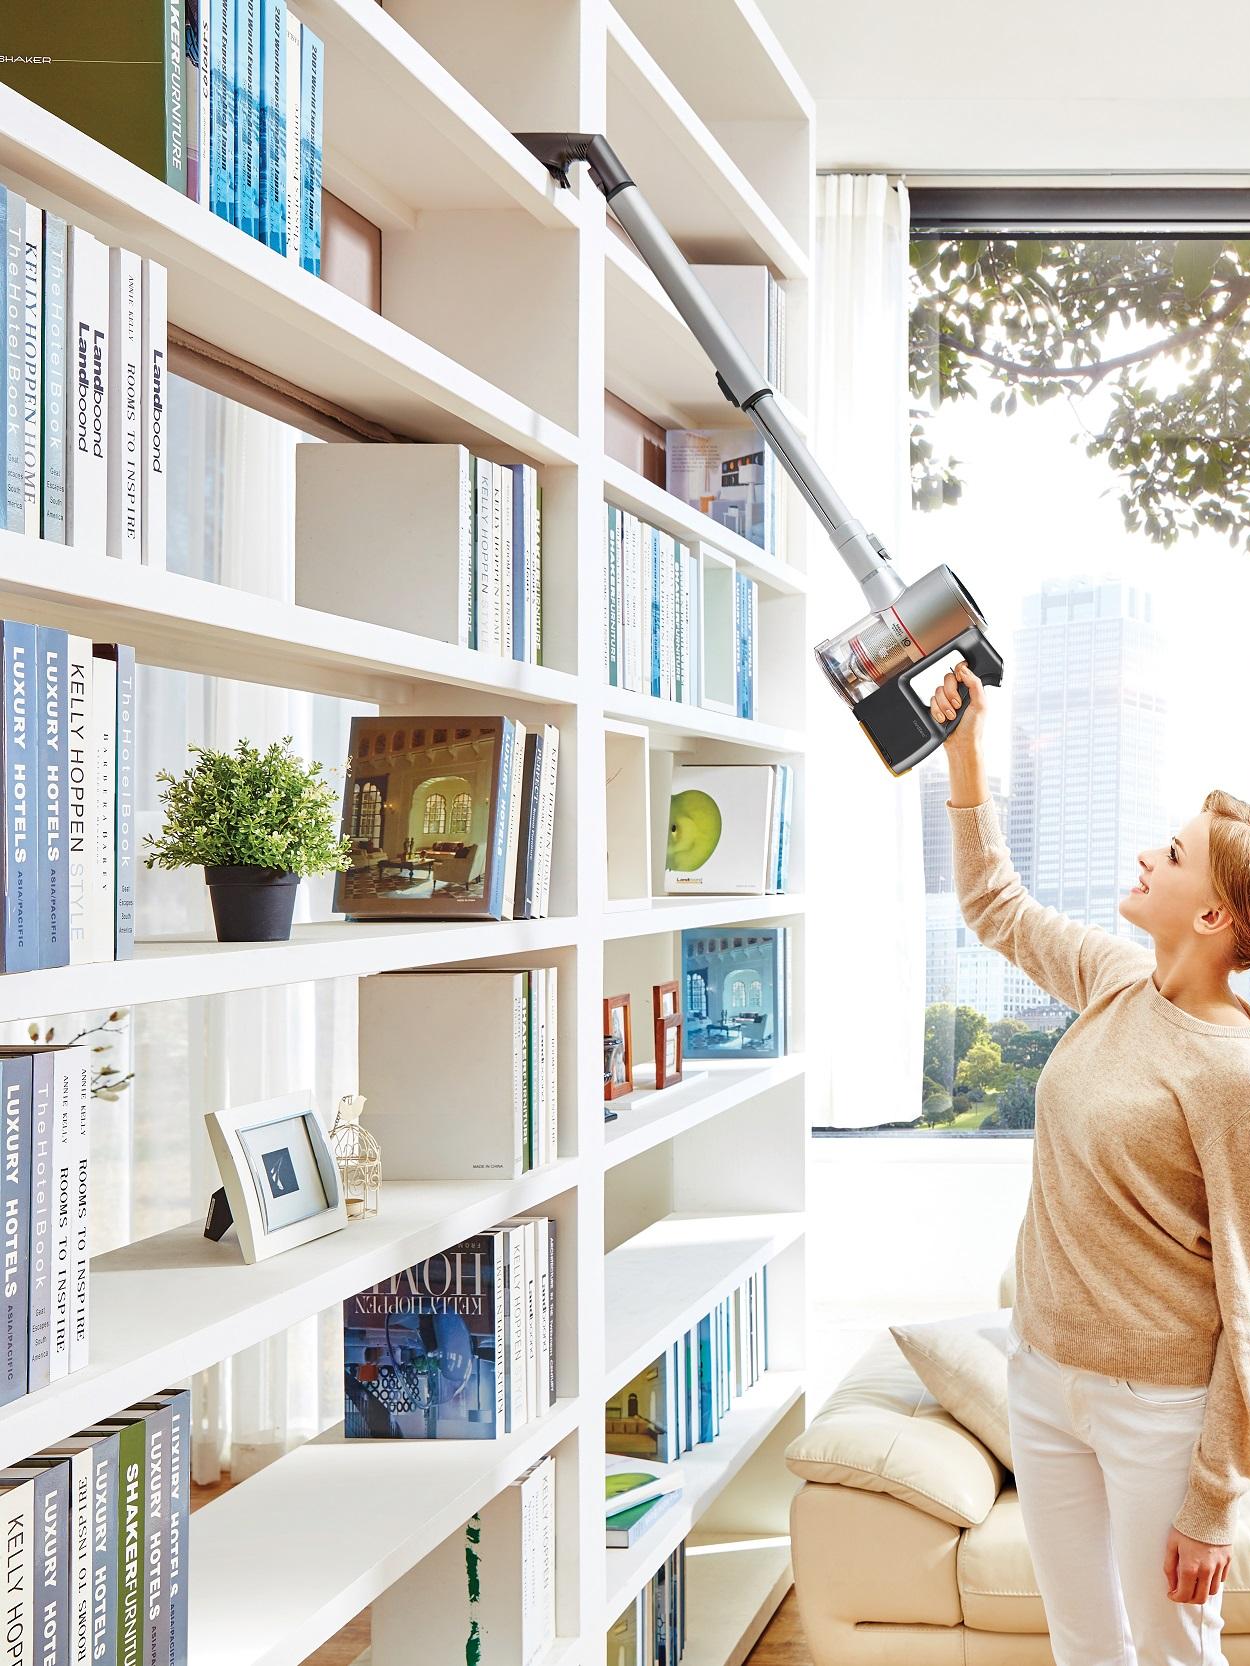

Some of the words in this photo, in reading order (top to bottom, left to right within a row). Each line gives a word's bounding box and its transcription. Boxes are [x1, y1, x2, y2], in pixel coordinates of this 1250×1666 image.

[25, 323, 37, 426] HOPPEN
[78, 321, 90, 453] Landboond
[93, 329, 105, 458] Landboond
[127, 363, 136, 421] ROOMS
[152, 349, 164, 474] Landboond
[24, 432, 36, 504] HOME
[127, 434, 135, 452] TO
[126, 460, 136, 540] INSPIRE
[481, 475, 489, 525] KELLY
[481, 528, 489, 594] HOPPEN
[13, 647, 26, 750] LUXURY
[46, 651, 59, 752] LUXURY
[70, 663, 84, 740] KELLY
[70, 749, 84, 852] HOPPEN
[503, 734, 511, 793] LUXURY
[14, 764, 26, 863] HOTELS
[47, 765, 60, 862] HOTELS
[498, 799, 506, 857] HOTELS
[70, 863, 84, 942] STYLE
[6, 1084, 20, 1184] LUXURY
[60, 1167, 69, 1227] ROOMS
[79, 1159, 88, 1219] ROOMS
[5, 1199, 18, 1298] HOTELS
[58, 1240, 68, 1261] TO
[78, 1231, 87, 1251] TO
[513, 1244, 521, 1290] KELLY
[57, 1270, 68, 1353] INSPIRE
[76, 1258, 86, 1342] INSPIRE
[427, 1296, 483, 1315] KELLY
[514, 1296, 522, 1361] HOPPEN
[95, 1459, 108, 1553] LUXURY
[149, 1430, 163, 1519] LUXURY
[7, 1513, 24, 1594] KELLY
[44, 1489, 57, 1588] LUXURY
[79, 1476, 88, 1561] INSPIRE
[78, 1567, 87, 1594] TO
[94, 1565, 107, 1660] HOTELS
[149, 1530, 162, 1621] HOTELS
[78, 1599, 87, 1662] ROOMS
